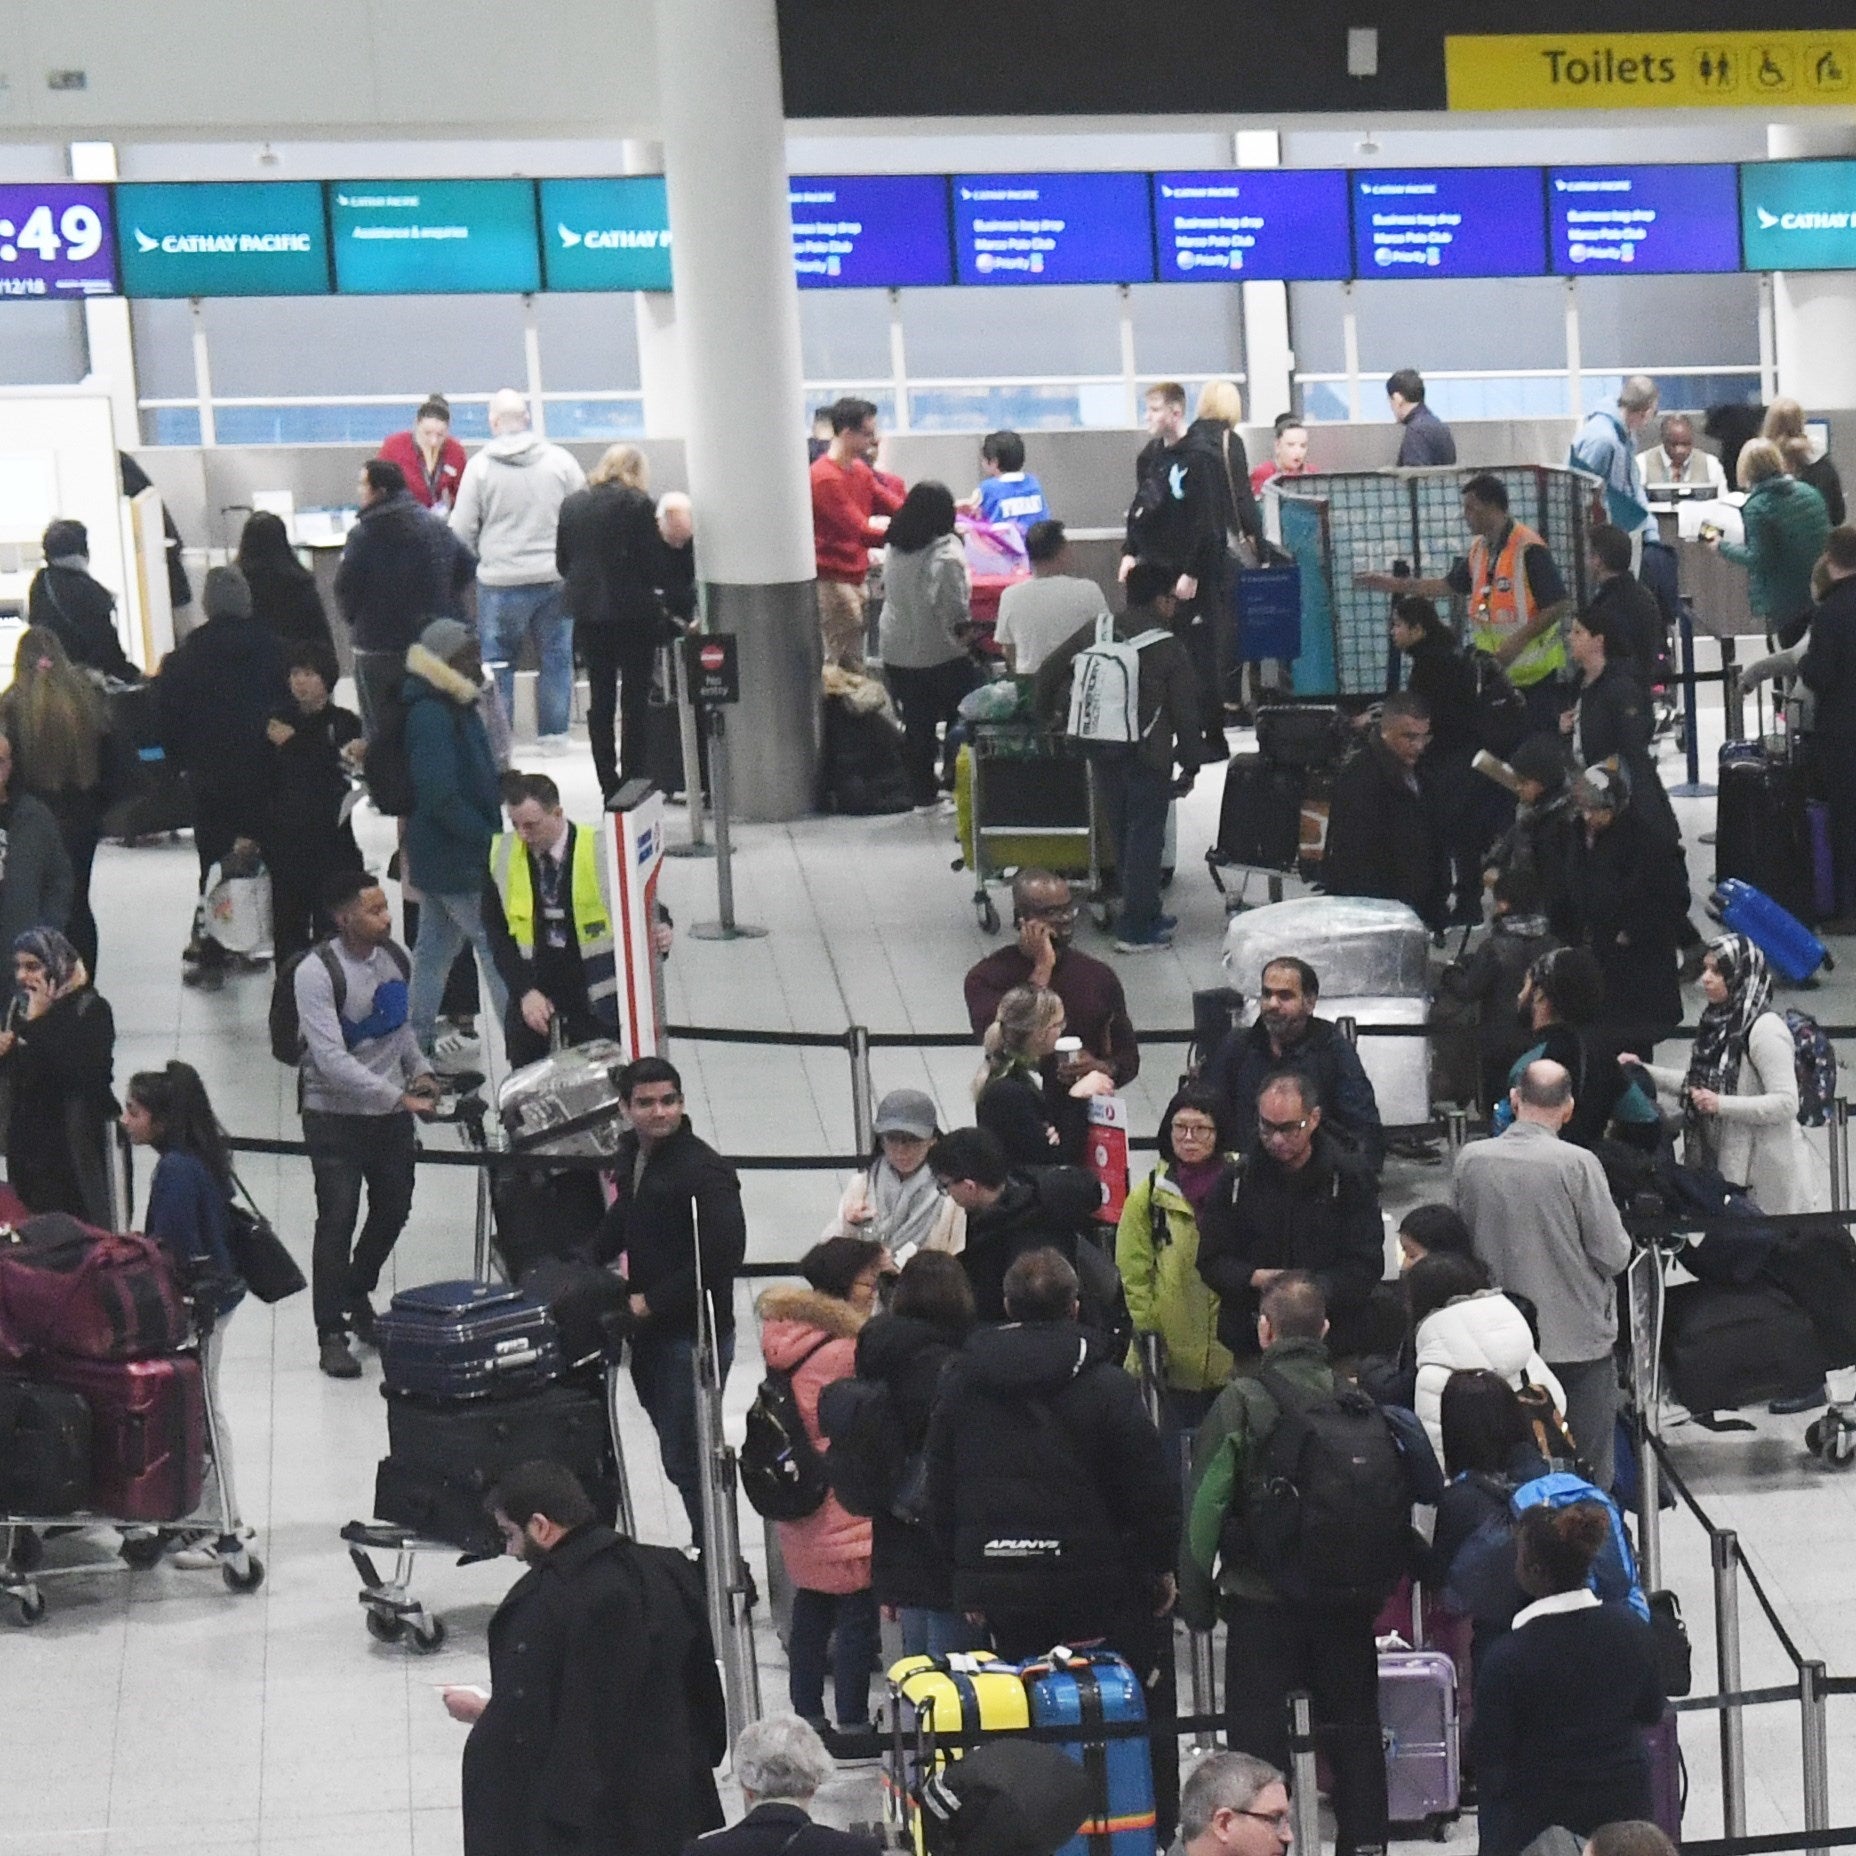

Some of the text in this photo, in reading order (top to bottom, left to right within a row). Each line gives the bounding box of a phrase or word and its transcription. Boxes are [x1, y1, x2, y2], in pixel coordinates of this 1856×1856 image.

[1541, 49, 1676, 85] Toilets
[1780, 213, 1849, 229] CATHAY
[161, 233, 311, 253] CATHAY PACIFIC
[584, 230, 658, 249] CATHAY
[705, 674, 722, 686] No
[700, 684, 729, 697] entry
